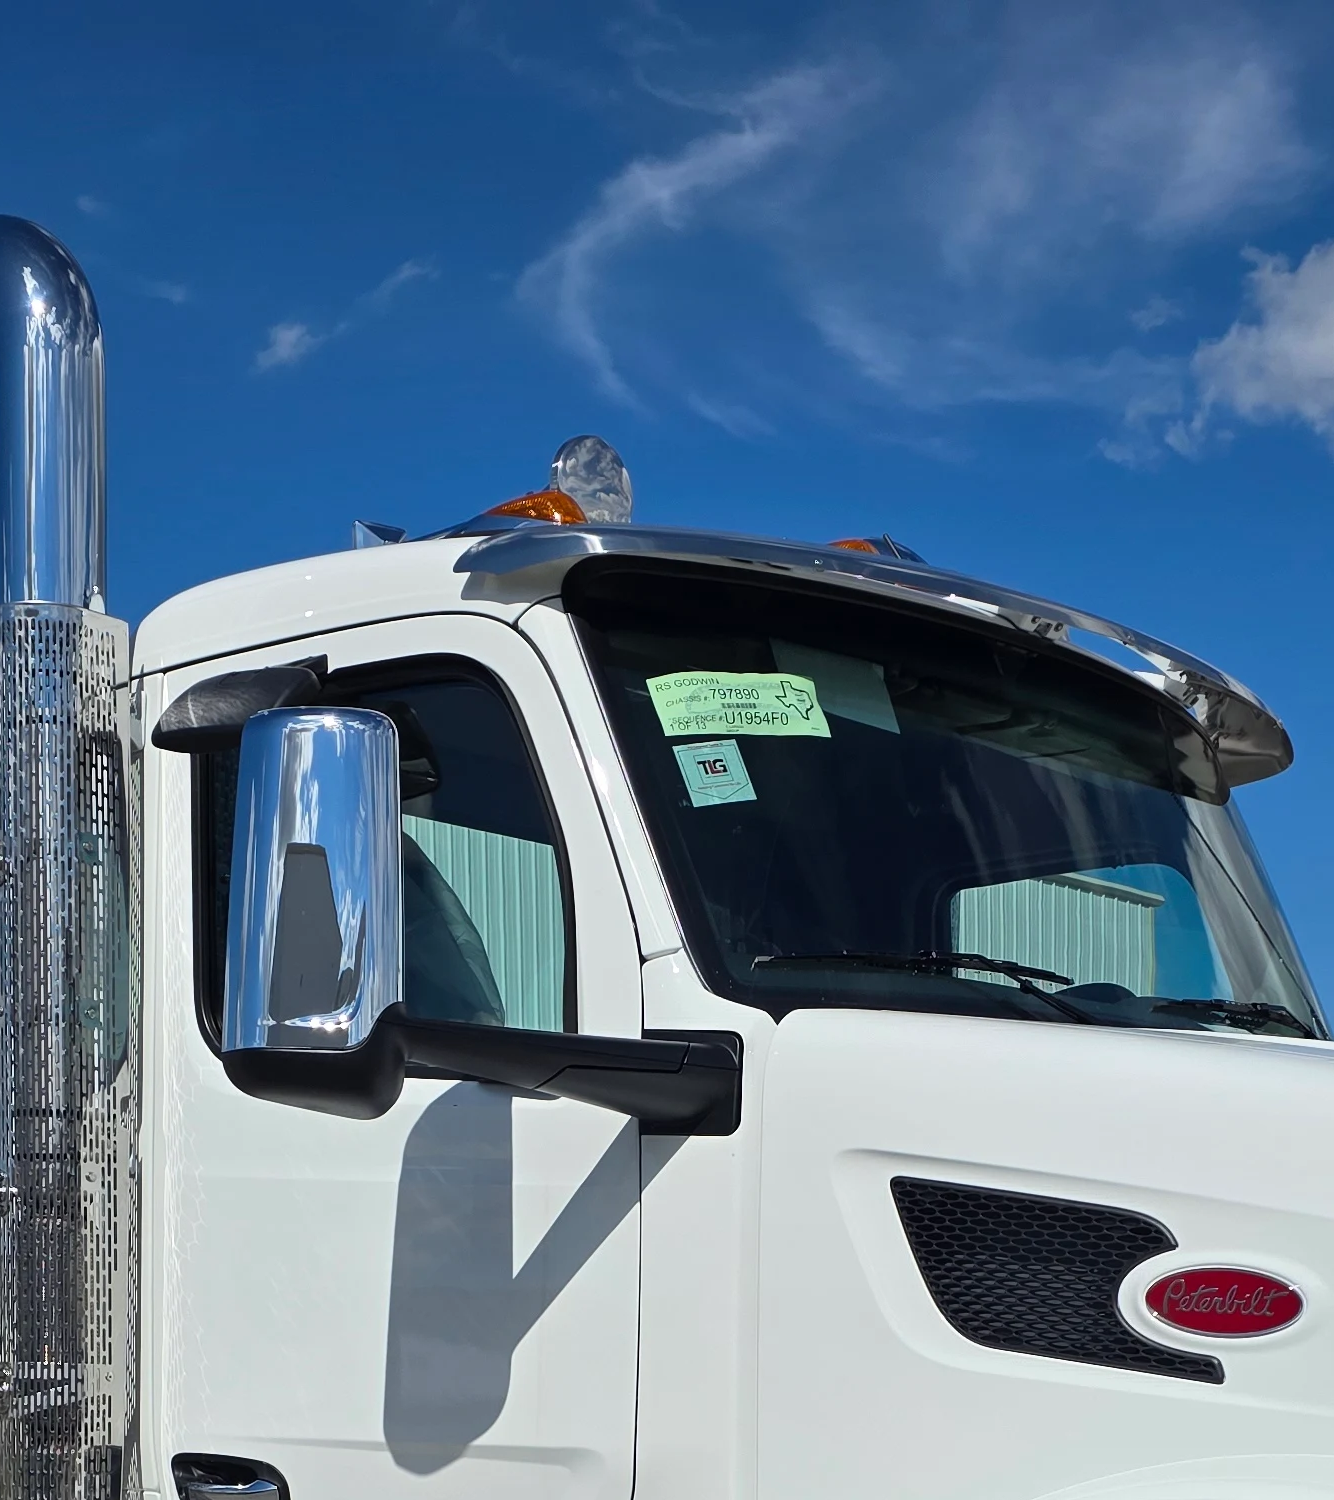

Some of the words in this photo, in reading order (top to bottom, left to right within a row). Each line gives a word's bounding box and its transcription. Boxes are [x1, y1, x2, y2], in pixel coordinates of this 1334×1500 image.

[655, 682, 671, 692] RS
[674, 678, 719, 687] GODWIN
[709, 689, 759, 700] 797890
[724, 711, 789, 725] U1954F0
[696, 758, 728, 775] TLG
[1163, 1278, 1289, 1317] Peterbilt
